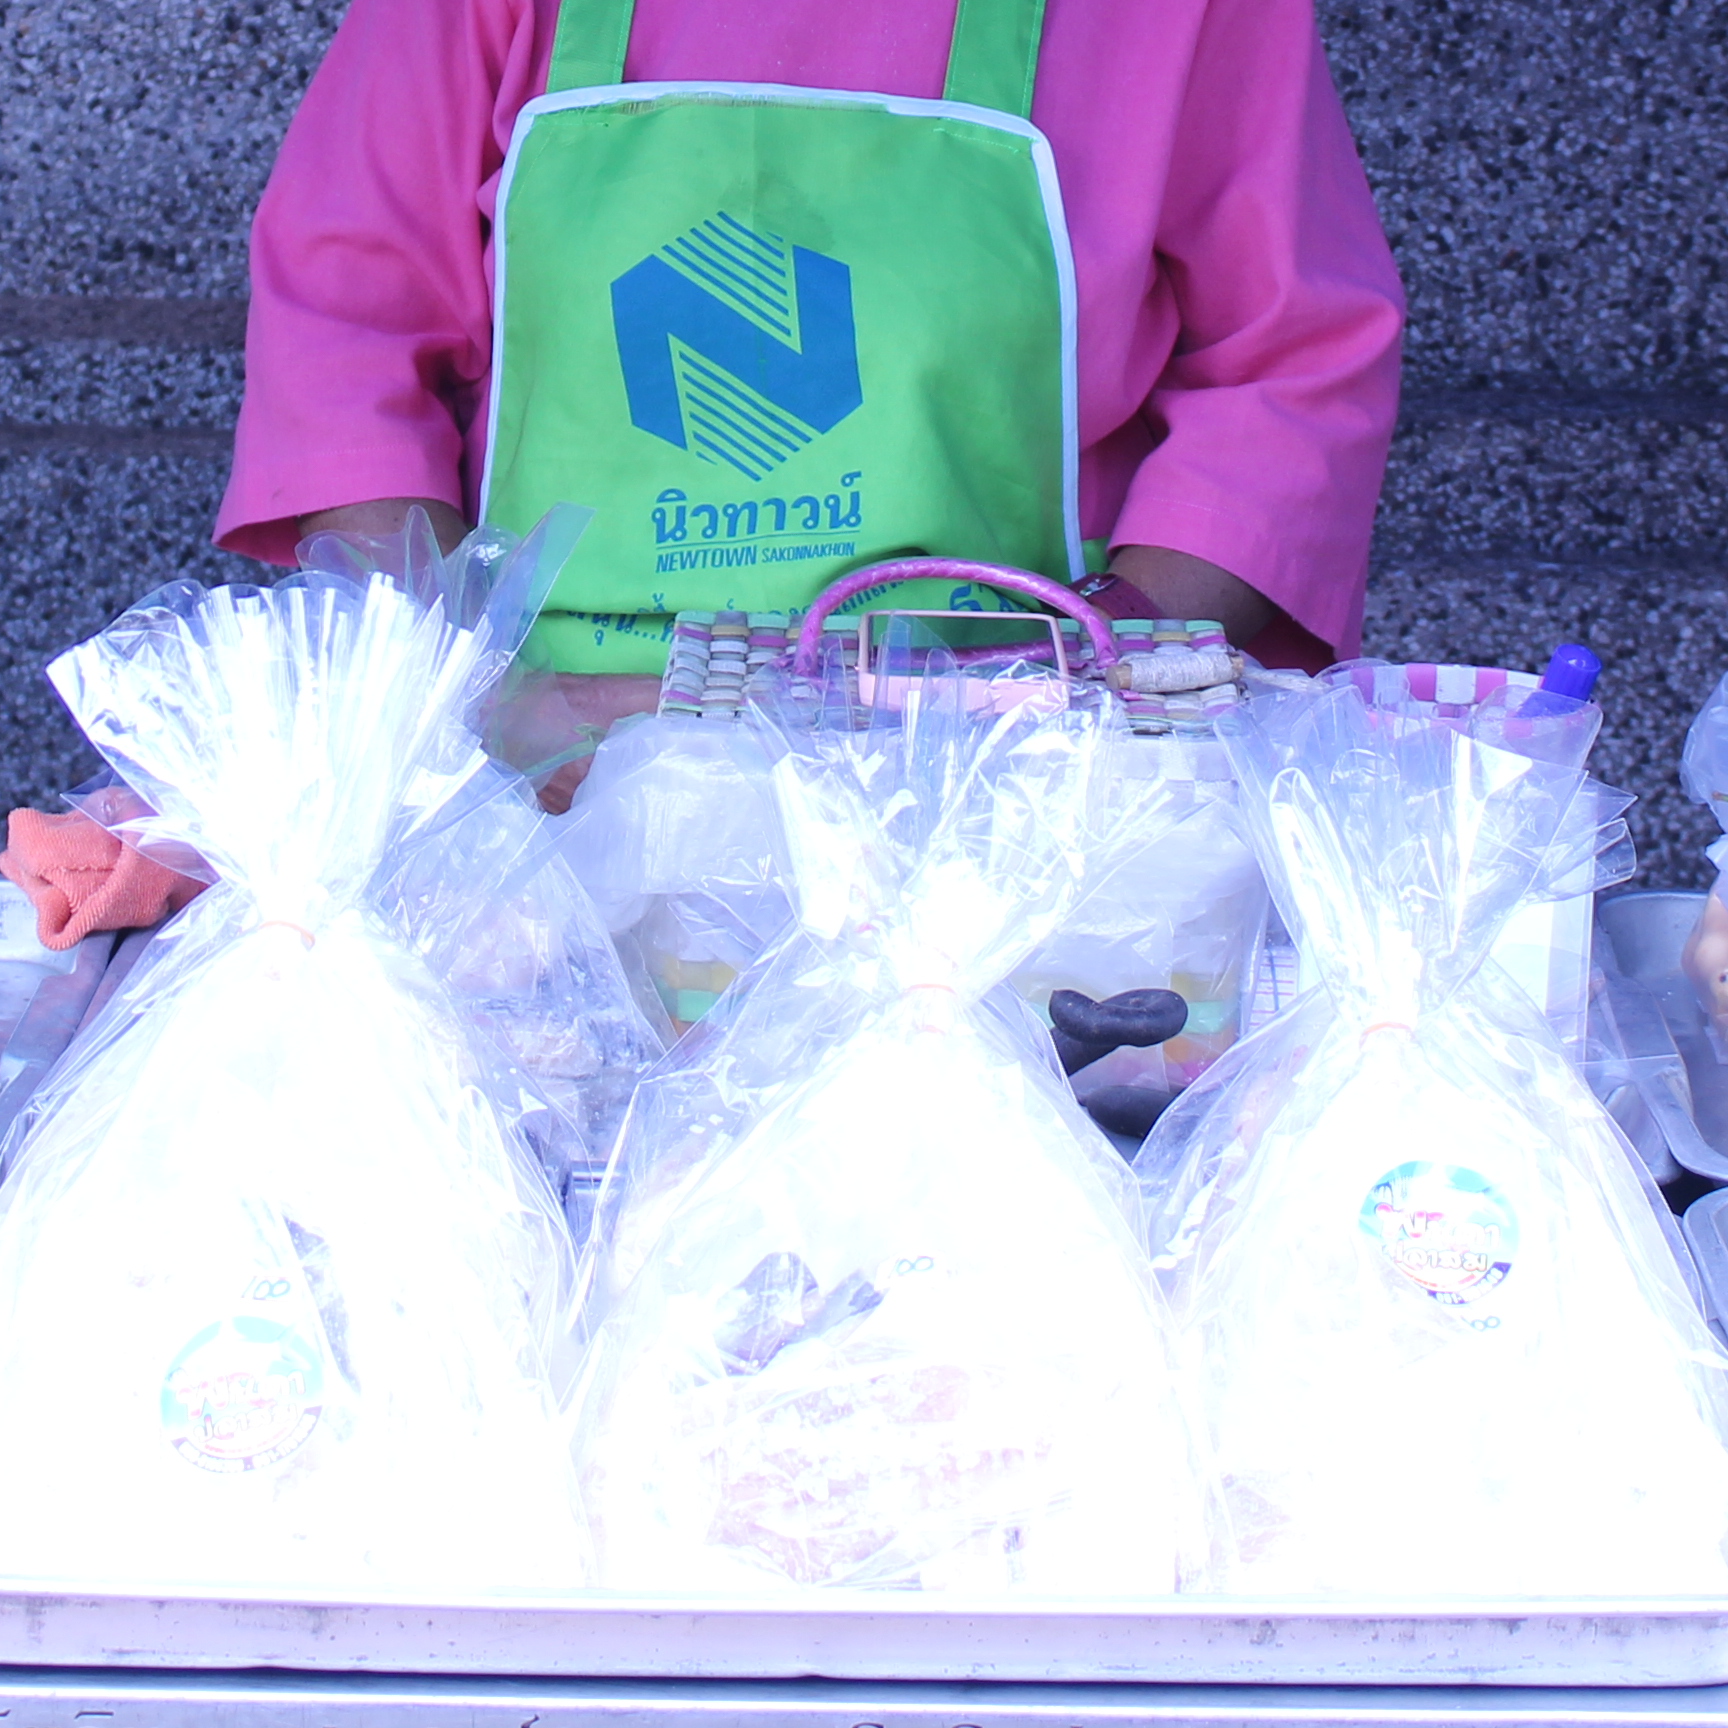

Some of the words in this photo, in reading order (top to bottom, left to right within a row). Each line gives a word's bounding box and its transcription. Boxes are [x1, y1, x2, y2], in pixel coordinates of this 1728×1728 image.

[651, 471, 862, 544] นิวทาวน์
[656, 545, 757, 573] NEWTOWN
[761, 542, 855, 563] SAKONNAKHON
[241, 1275, 291, 1301] 100
